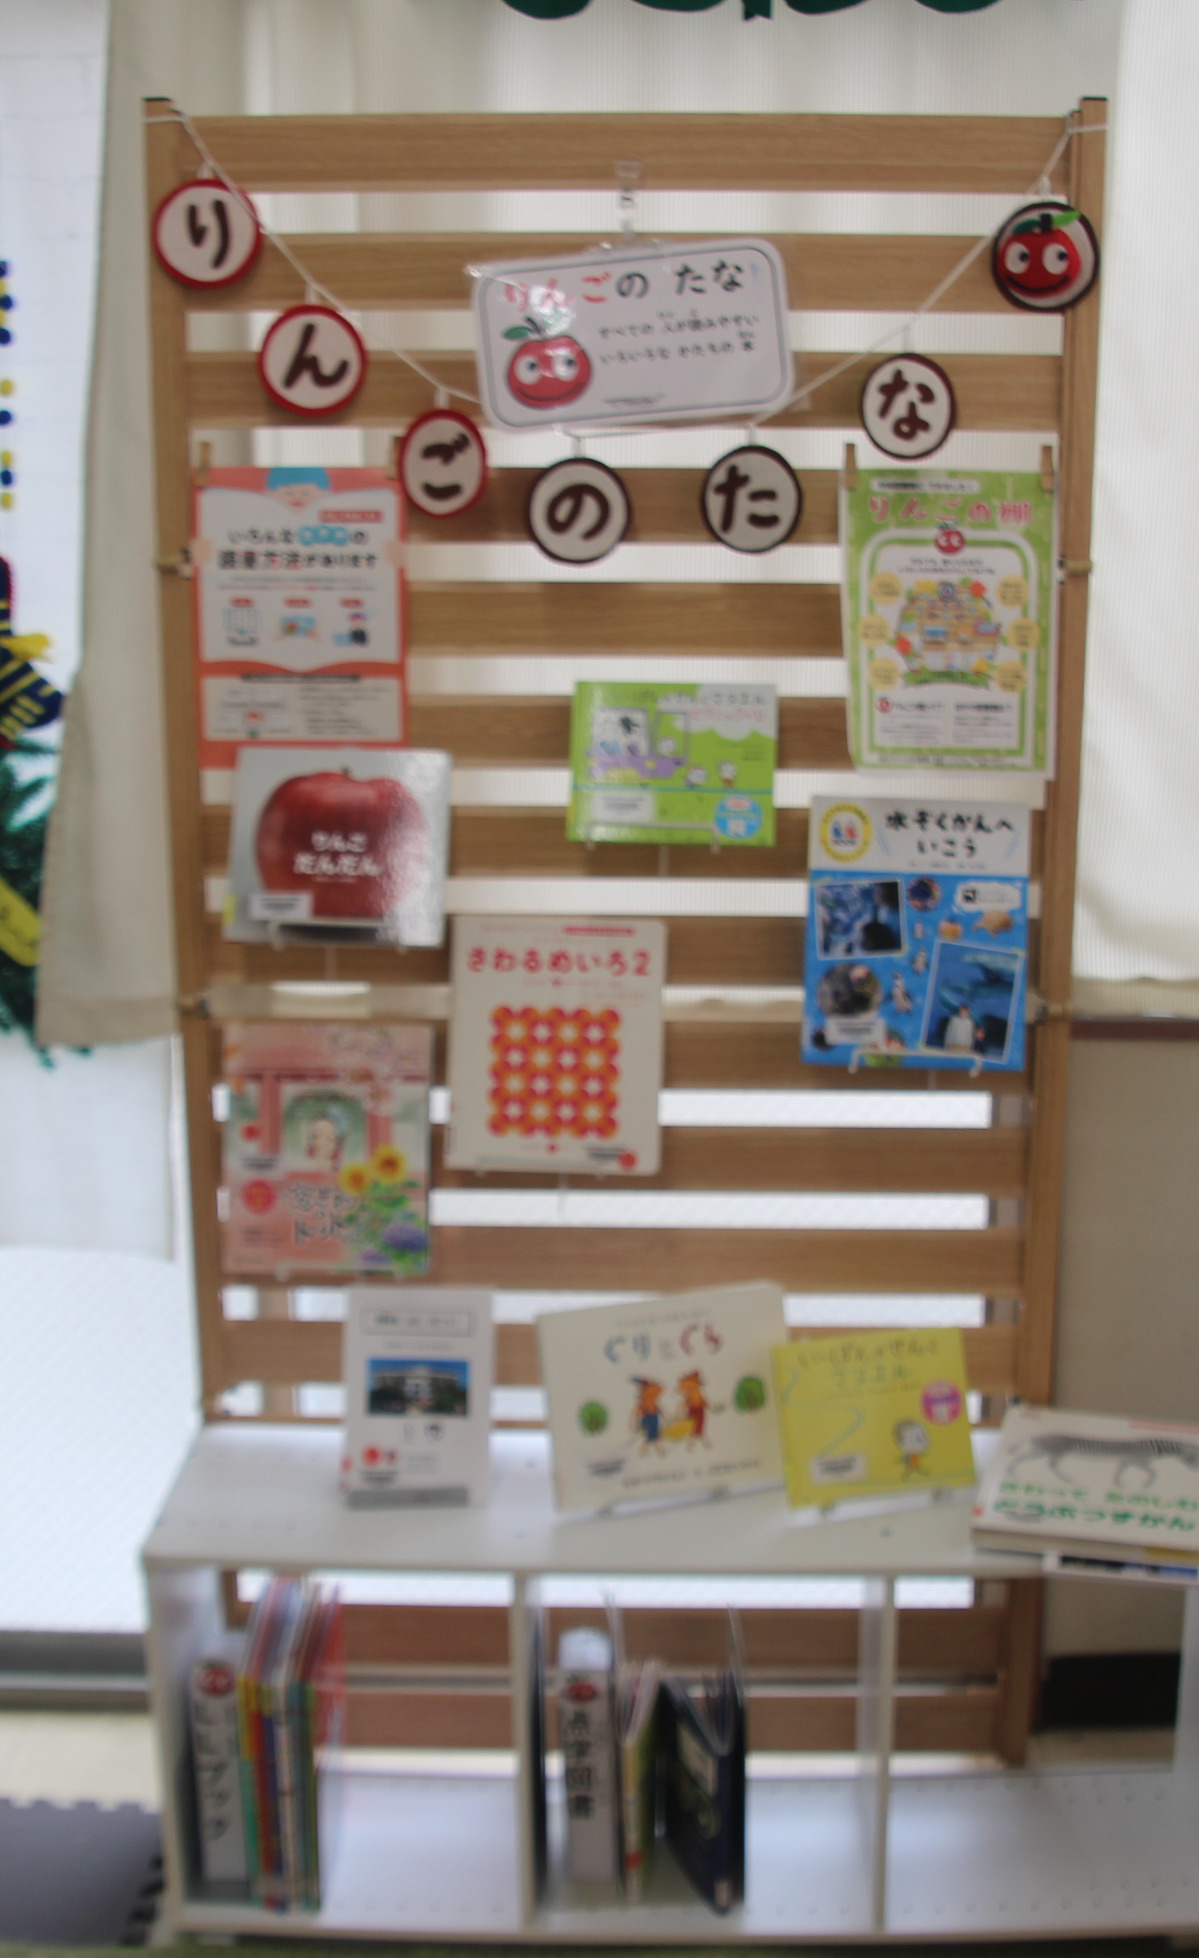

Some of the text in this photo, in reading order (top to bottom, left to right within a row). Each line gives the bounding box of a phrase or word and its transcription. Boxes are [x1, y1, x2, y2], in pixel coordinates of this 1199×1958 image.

[675, 257, 746, 296] たな
[869, 496, 1032, 525] りんごの棚
